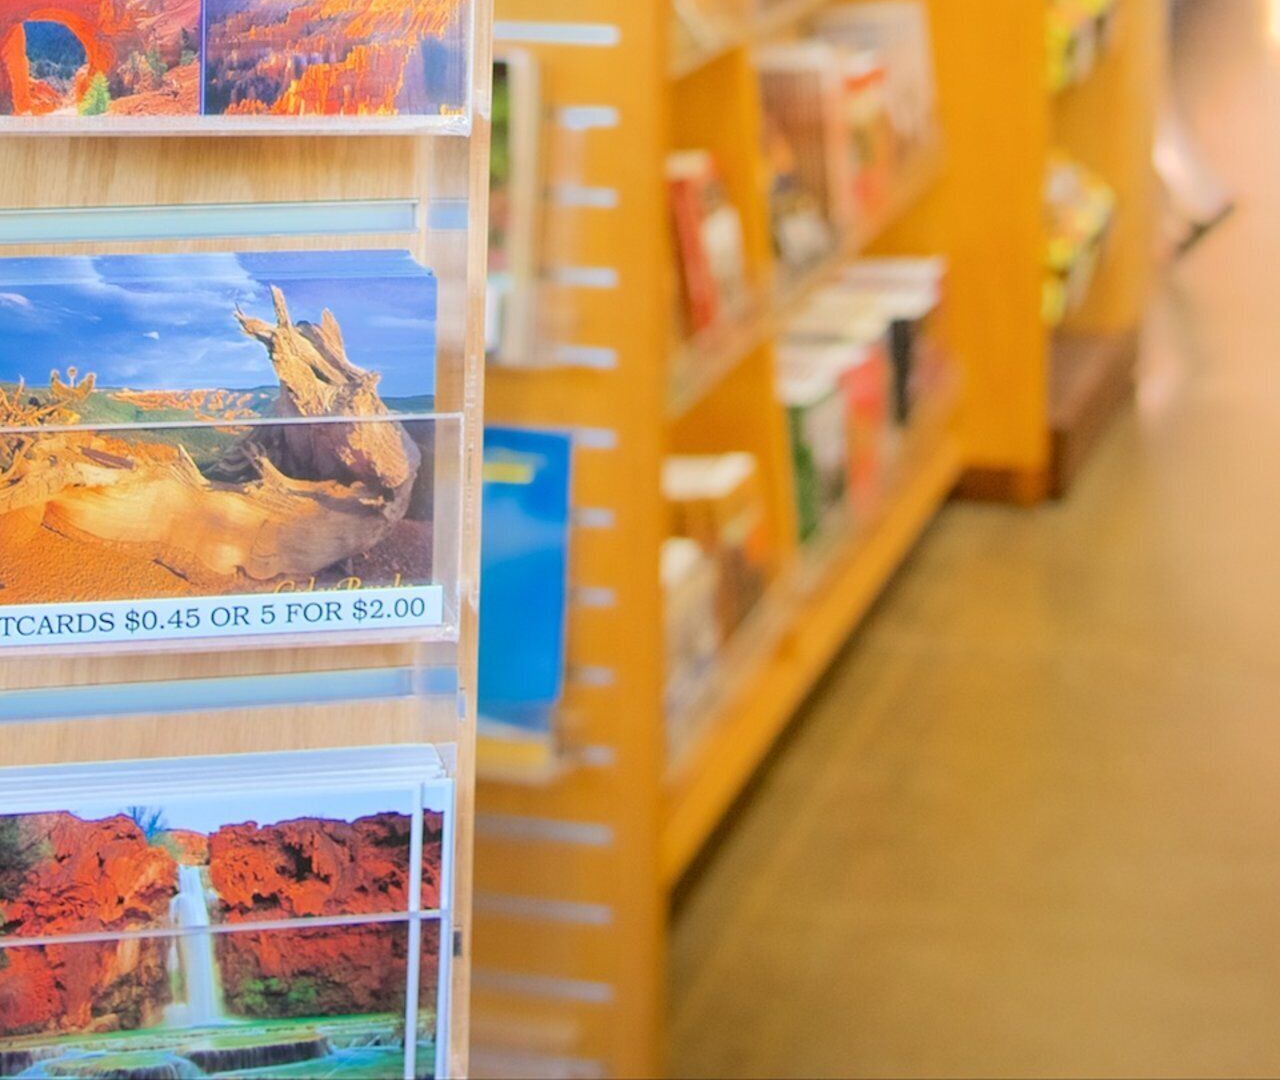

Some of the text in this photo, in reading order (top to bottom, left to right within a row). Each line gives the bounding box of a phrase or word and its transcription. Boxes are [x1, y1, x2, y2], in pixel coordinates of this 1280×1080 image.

[125, 607, 201, 633] $0.45
[210, 605, 250, 628] OR
[261, 604, 276, 626] 5
[286, 601, 343, 624] FOR
[352, 596, 426, 622] $2.00
